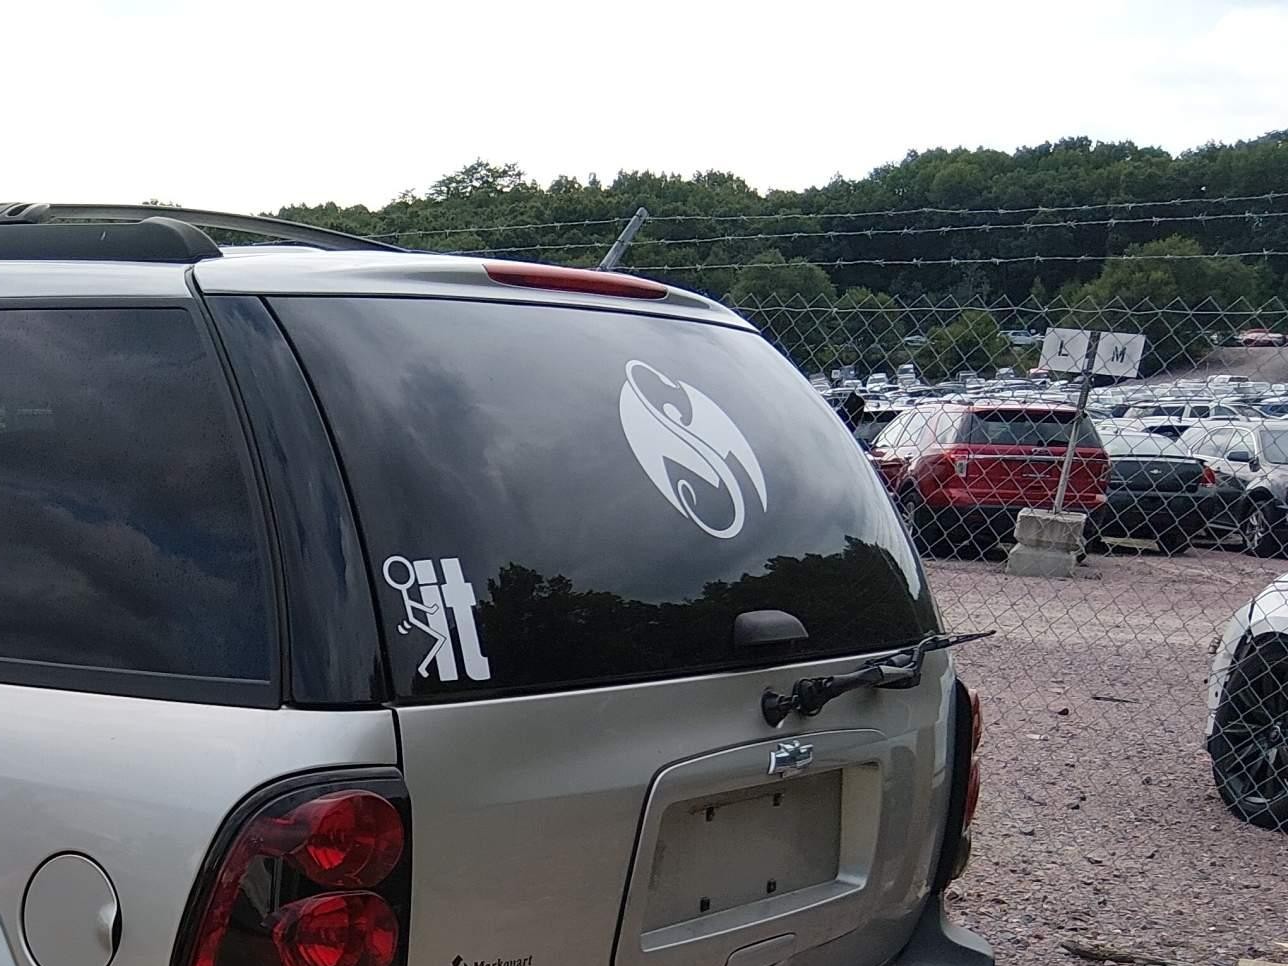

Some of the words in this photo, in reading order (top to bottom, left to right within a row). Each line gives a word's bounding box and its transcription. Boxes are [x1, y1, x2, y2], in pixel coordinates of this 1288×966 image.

[1057, 340, 1069, 357] L
[1111, 345, 1127, 363] M
[413, 557, 491, 682] it
